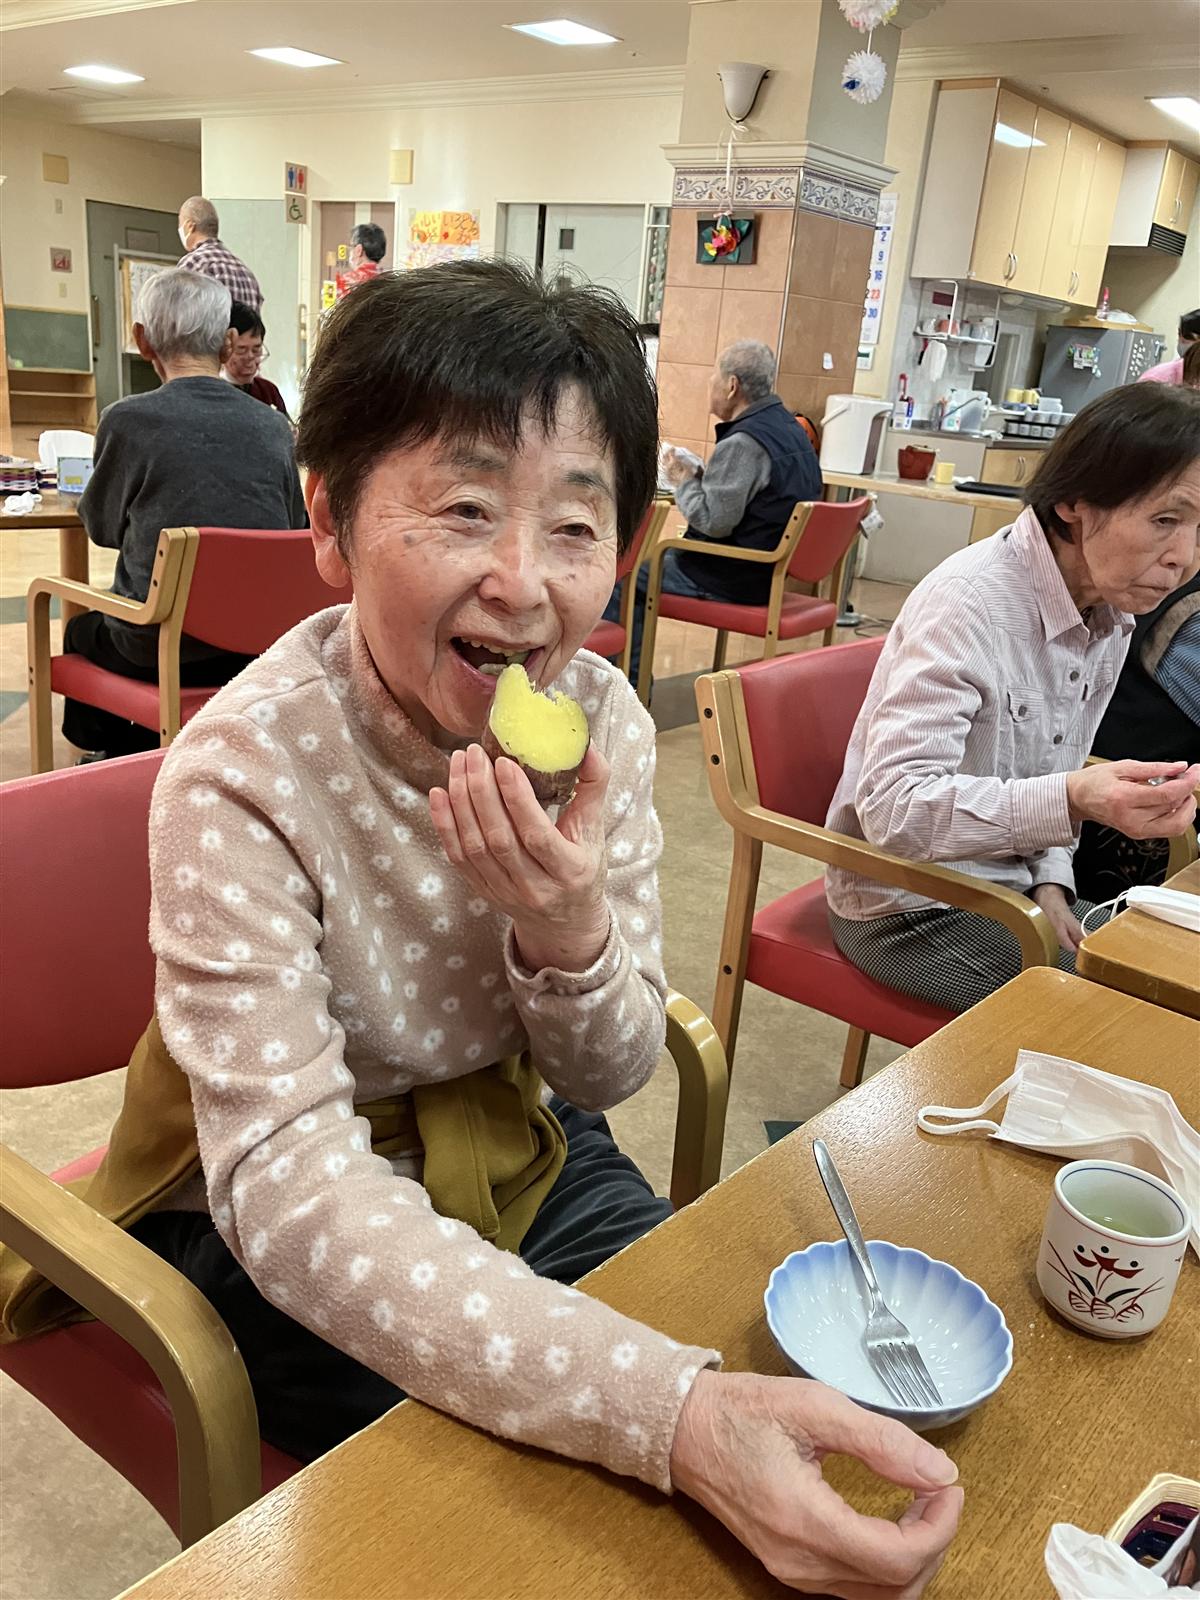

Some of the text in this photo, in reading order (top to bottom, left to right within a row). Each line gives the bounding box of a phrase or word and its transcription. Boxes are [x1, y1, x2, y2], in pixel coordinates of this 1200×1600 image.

[881, 231, 887, 242] 2
[878, 250, 884, 261] 9
[871, 288, 881, 300] 23
[868, 307, 878, 318] 30
